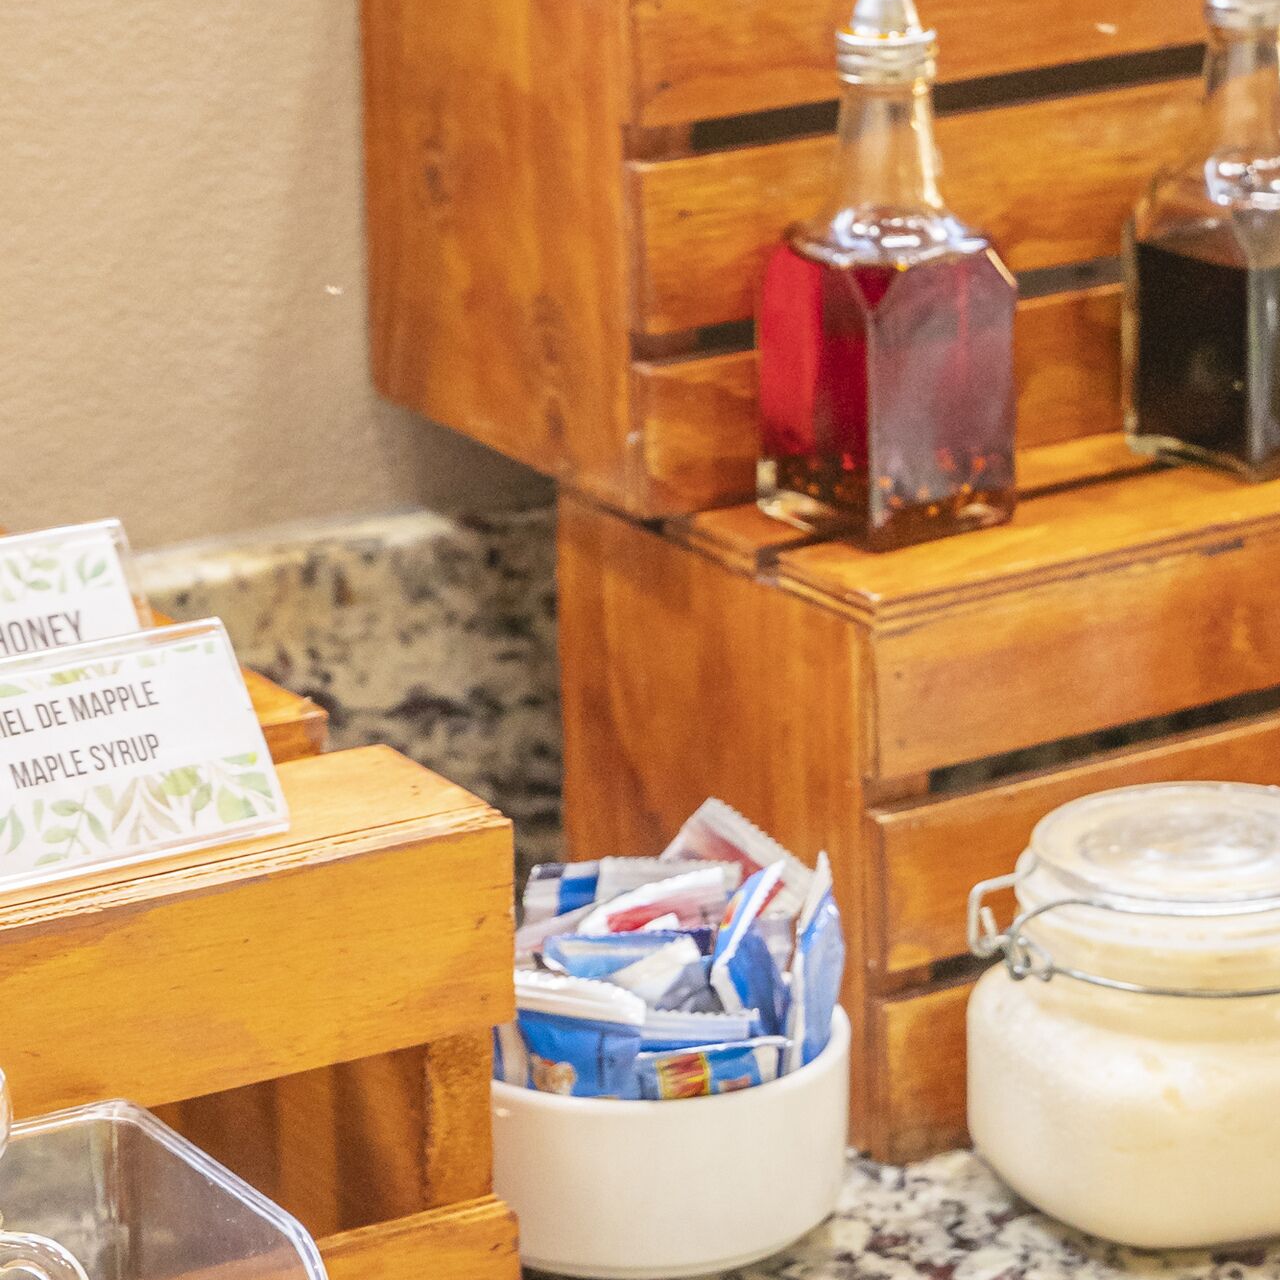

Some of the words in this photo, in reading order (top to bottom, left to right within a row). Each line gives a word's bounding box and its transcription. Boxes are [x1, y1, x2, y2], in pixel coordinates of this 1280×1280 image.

[0, 708, 34, 738] IEL
[34, 700, 67, 729] DE
[68, 680, 160, 722] MAPPLE
[9, 750, 88, 789] MAPLE
[89, 733, 160, 771] SYRUP
